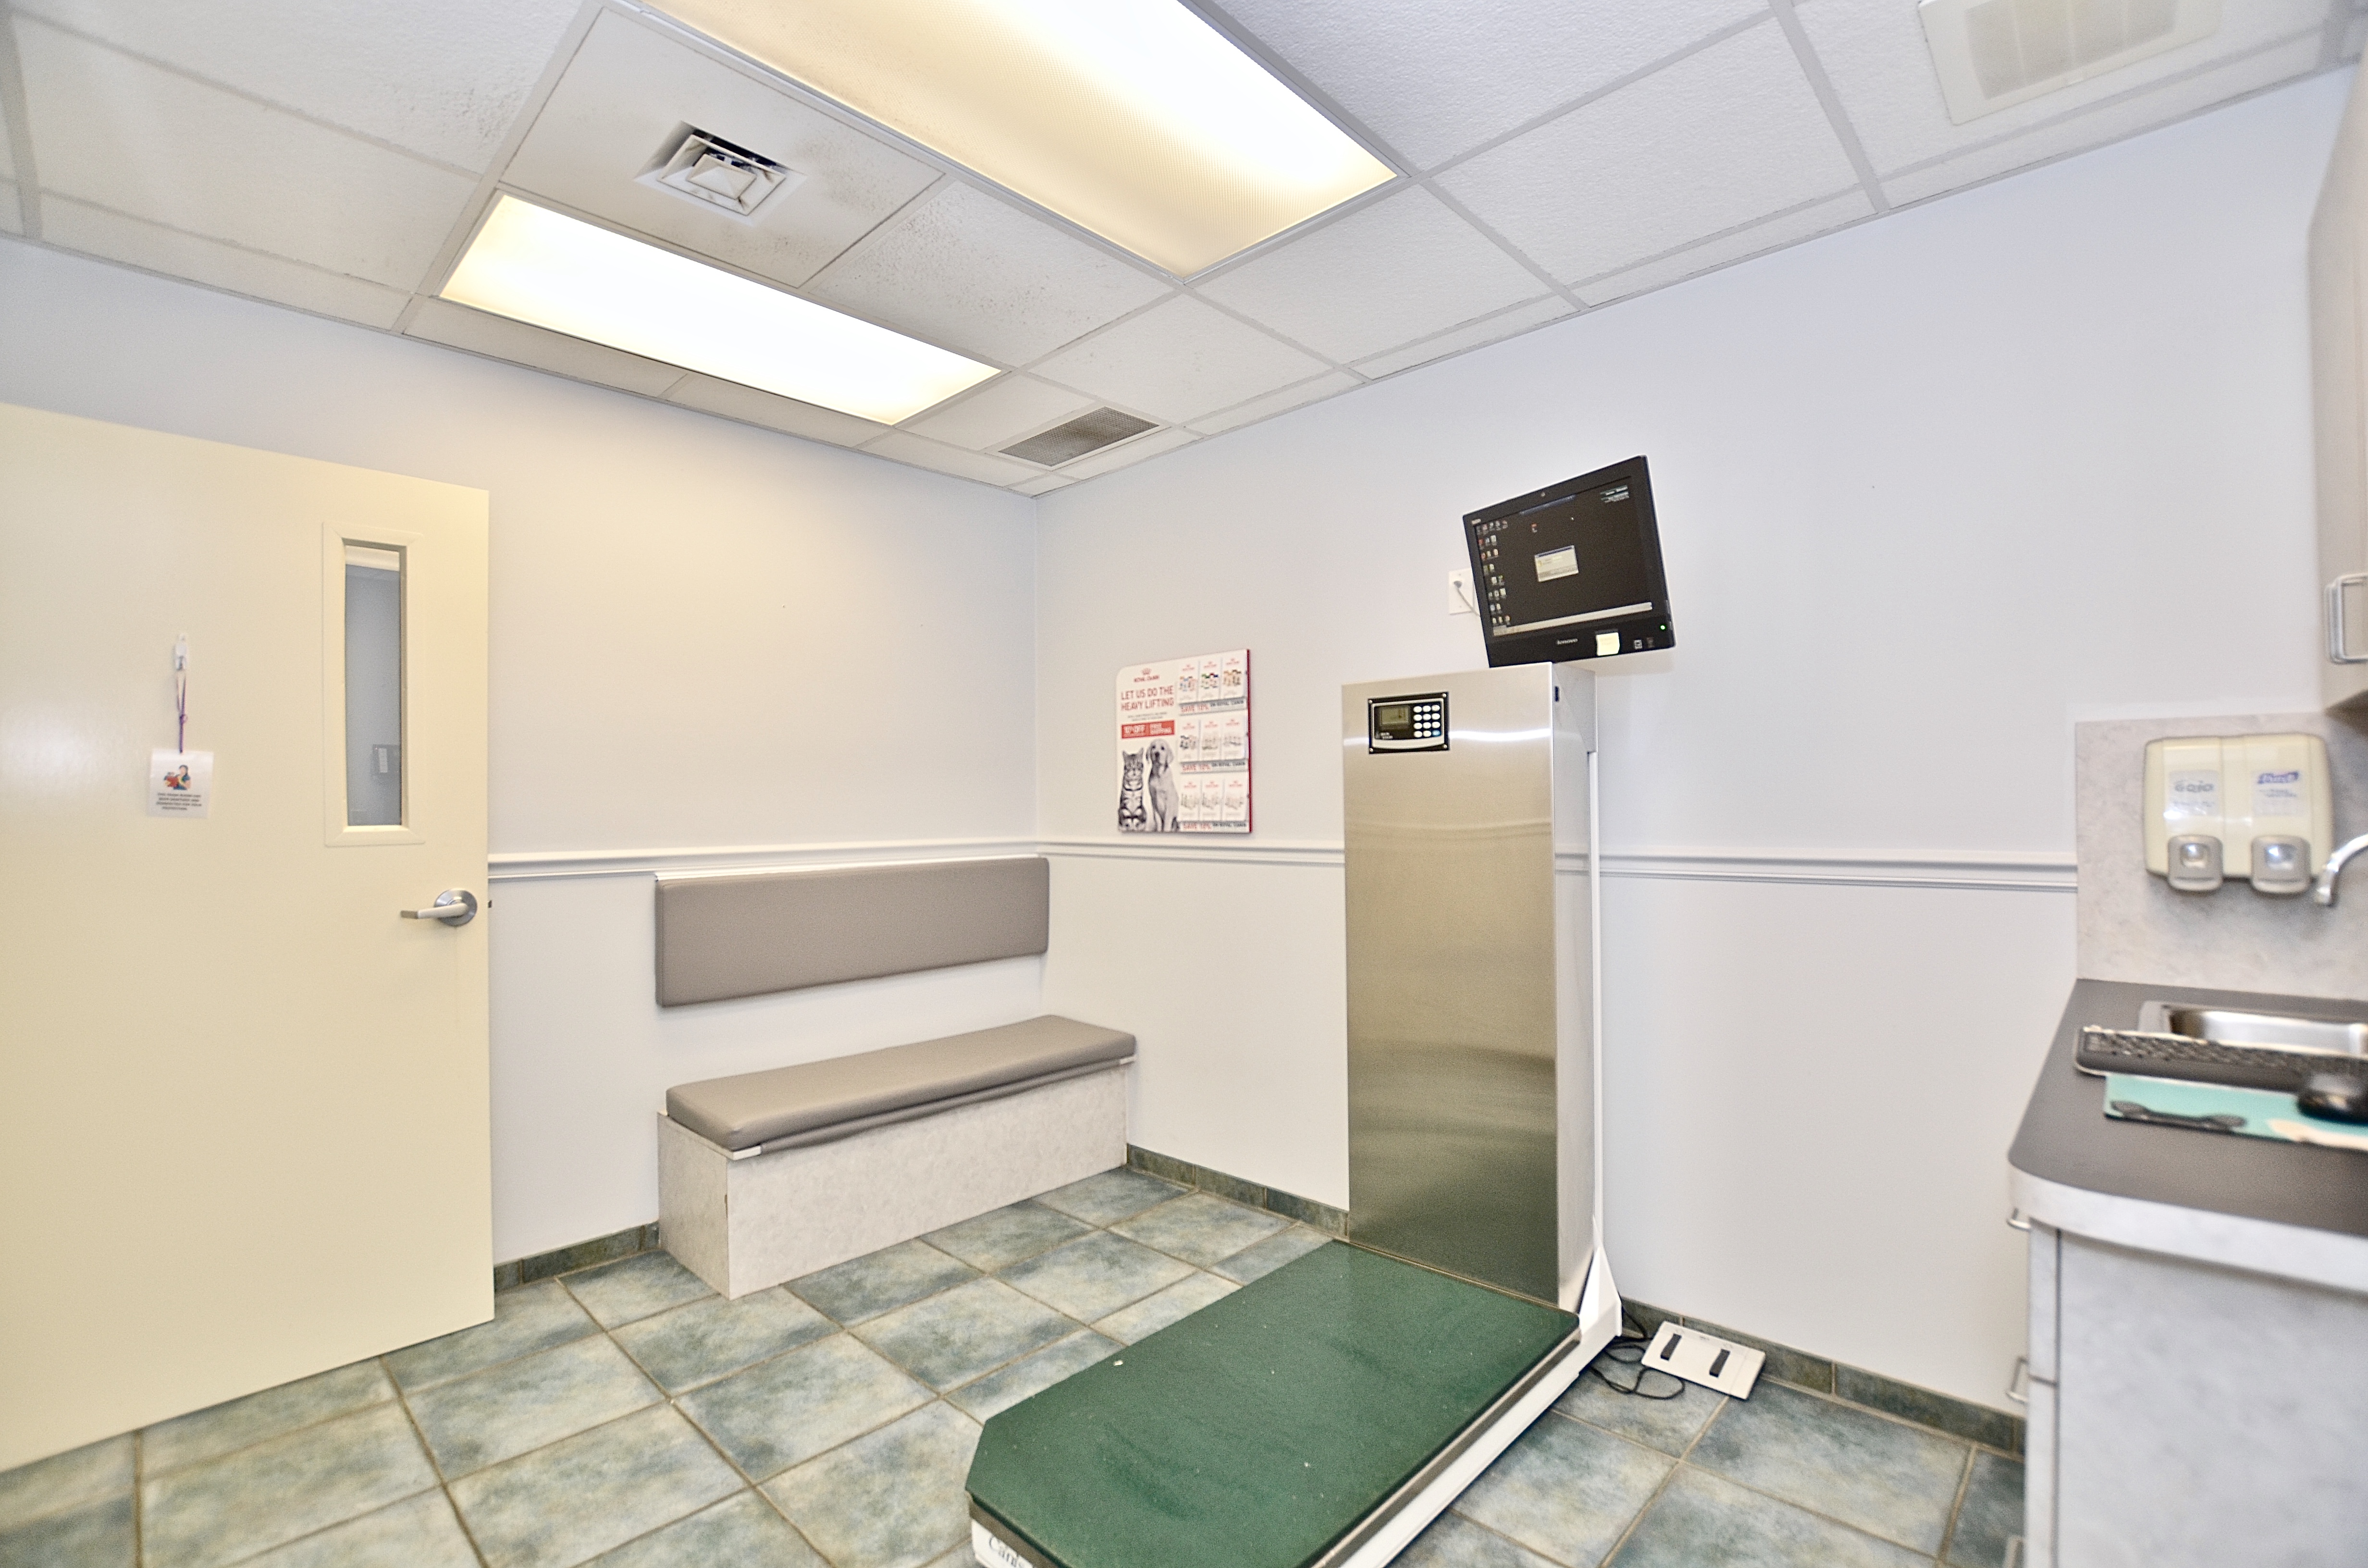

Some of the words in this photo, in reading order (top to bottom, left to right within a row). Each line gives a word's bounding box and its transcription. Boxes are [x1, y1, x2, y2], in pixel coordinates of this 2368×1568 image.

[1121, 690, 1134, 700] LET
[1135, 689, 1147, 698] US
[1147, 687, 1158, 697] DO
[1159, 685, 1173, 695] THE
[1121, 701, 1143, 711] HEAVY
[1144, 697, 1175, 710] LIFTING
